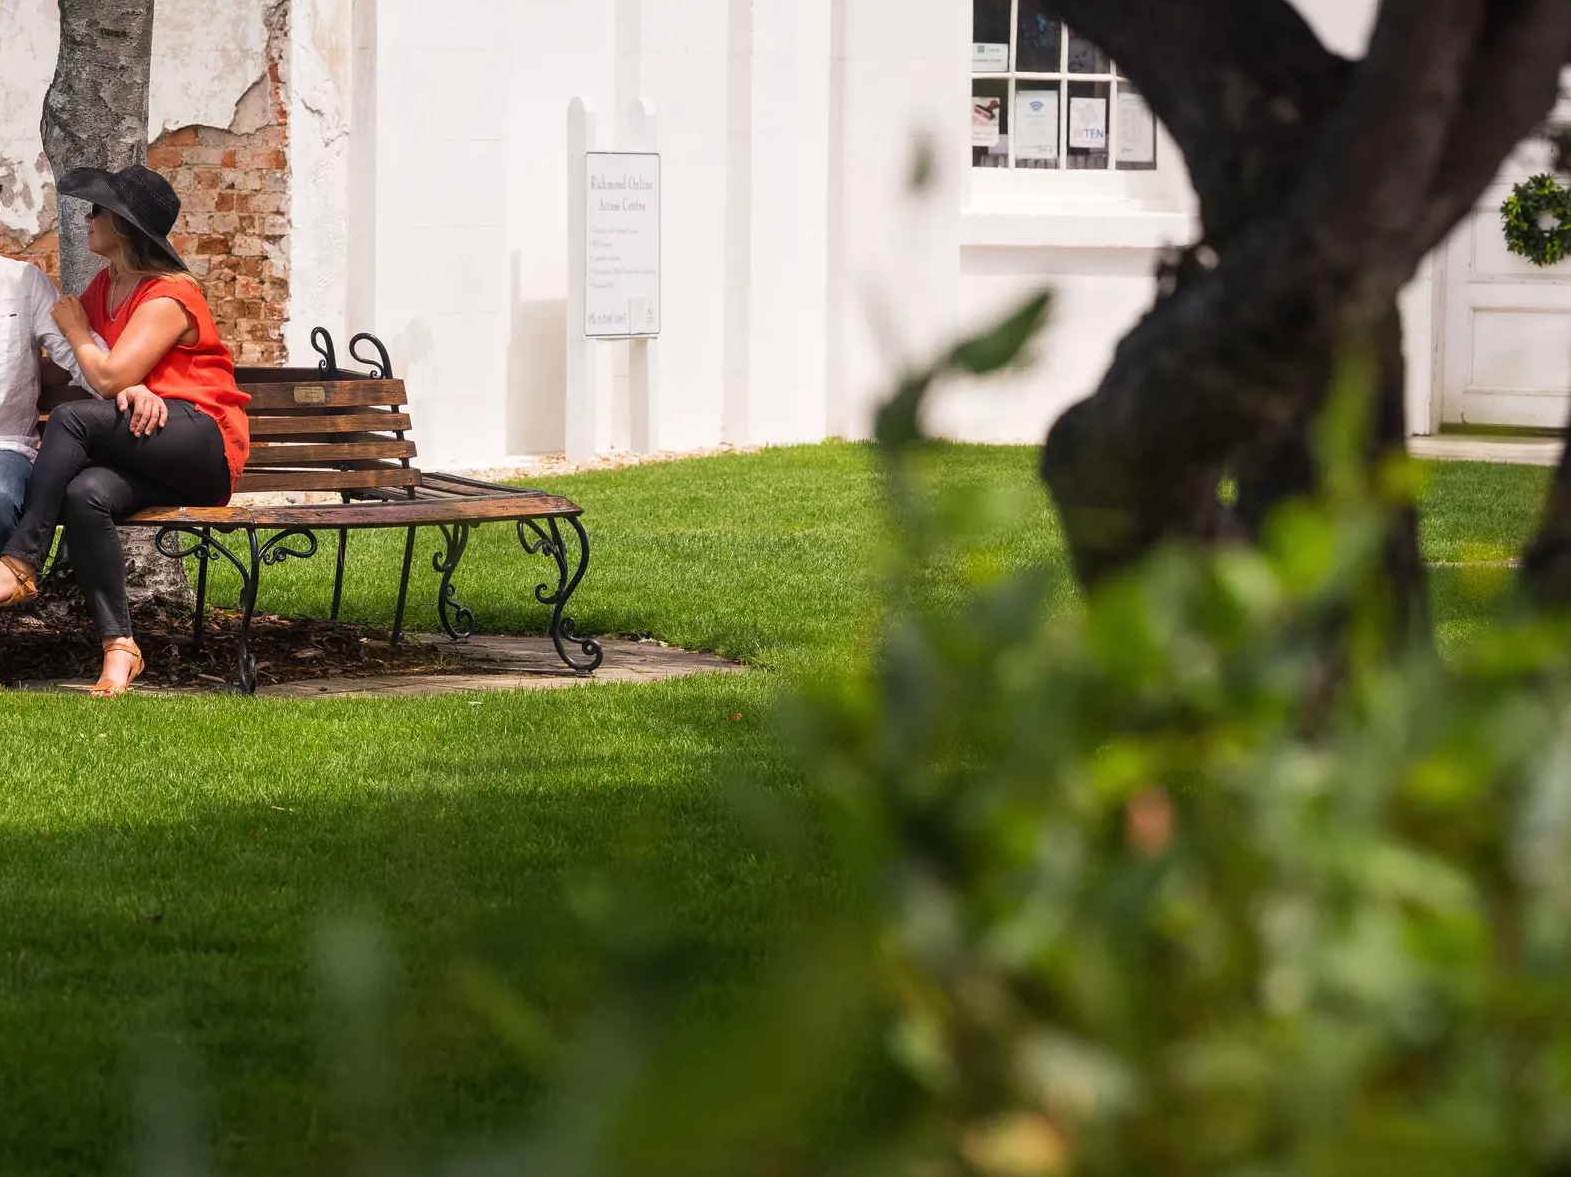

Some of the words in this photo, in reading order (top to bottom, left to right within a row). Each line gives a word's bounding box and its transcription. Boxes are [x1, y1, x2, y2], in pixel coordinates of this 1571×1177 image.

[590, 172, 626, 190] Richmond
[628, 172, 653, 190] Online
[598, 197, 620, 211] Access
[623, 196, 646, 211] Centre
